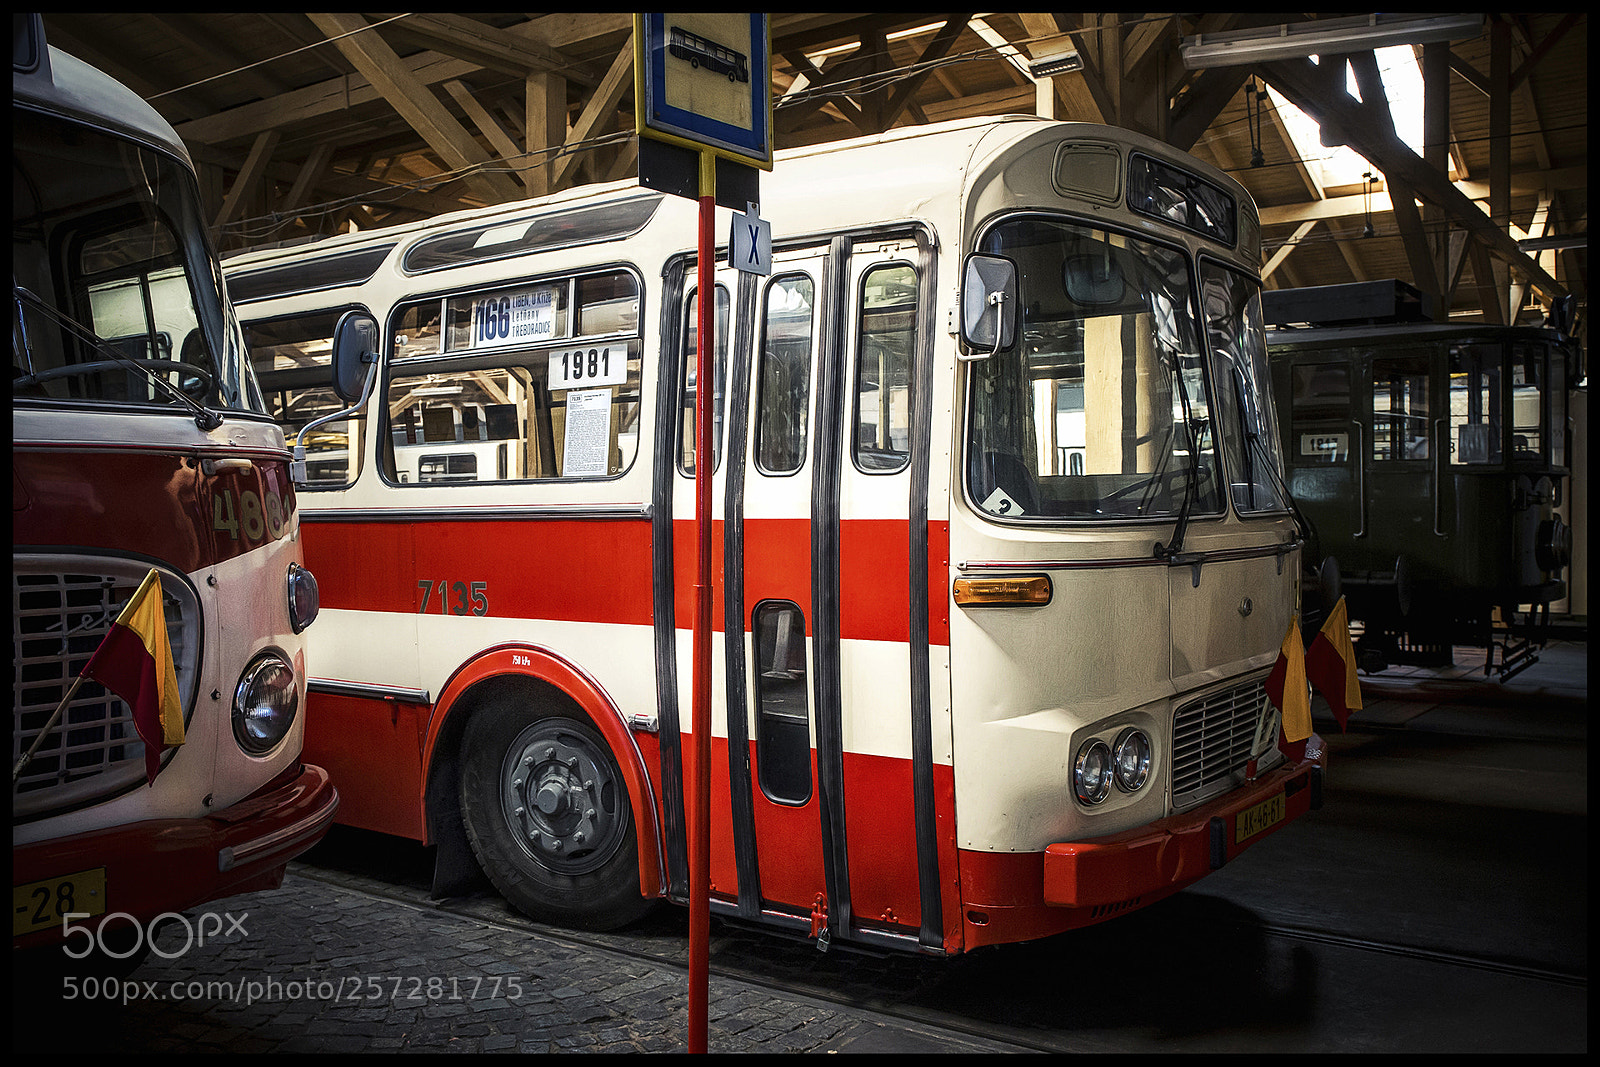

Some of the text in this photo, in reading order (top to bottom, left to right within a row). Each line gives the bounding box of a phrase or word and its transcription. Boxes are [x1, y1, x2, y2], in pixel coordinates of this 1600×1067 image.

[748, 224, 760, 265] X
[476, 296, 511, 342] 166
[562, 348, 610, 380] 1981
[418, 579, 488, 617] 7135
